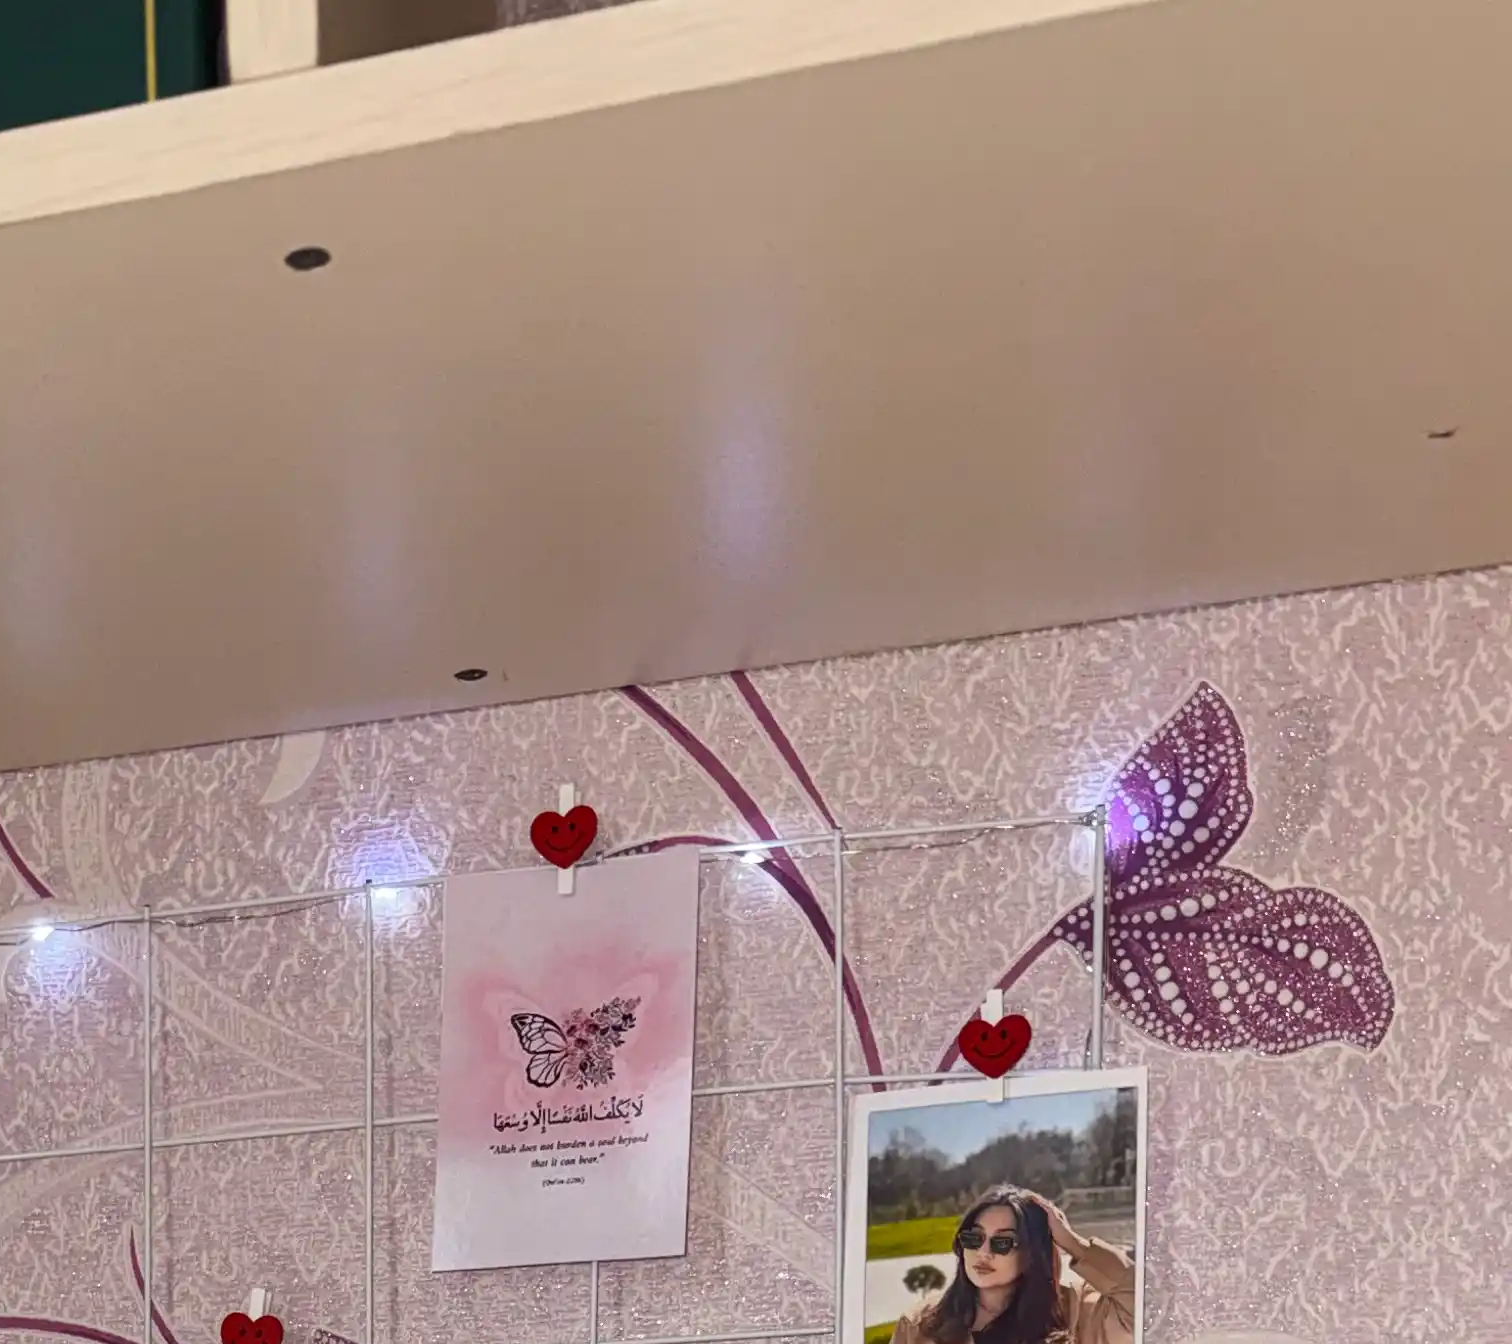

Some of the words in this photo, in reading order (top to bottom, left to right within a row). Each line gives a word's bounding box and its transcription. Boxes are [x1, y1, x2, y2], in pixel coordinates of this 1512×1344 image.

[519, 1143, 537, 1153] does
[539, 1143, 554, 1152] not
[556, 1140, 586, 1151] burden
[588, 1140, 595, 1148] a
[618, 1133, 649, 1147] beyond
[531, 1158, 548, 1168] that
[550, 1157, 558, 1167] it
[560, 1158, 576, 1167] can
